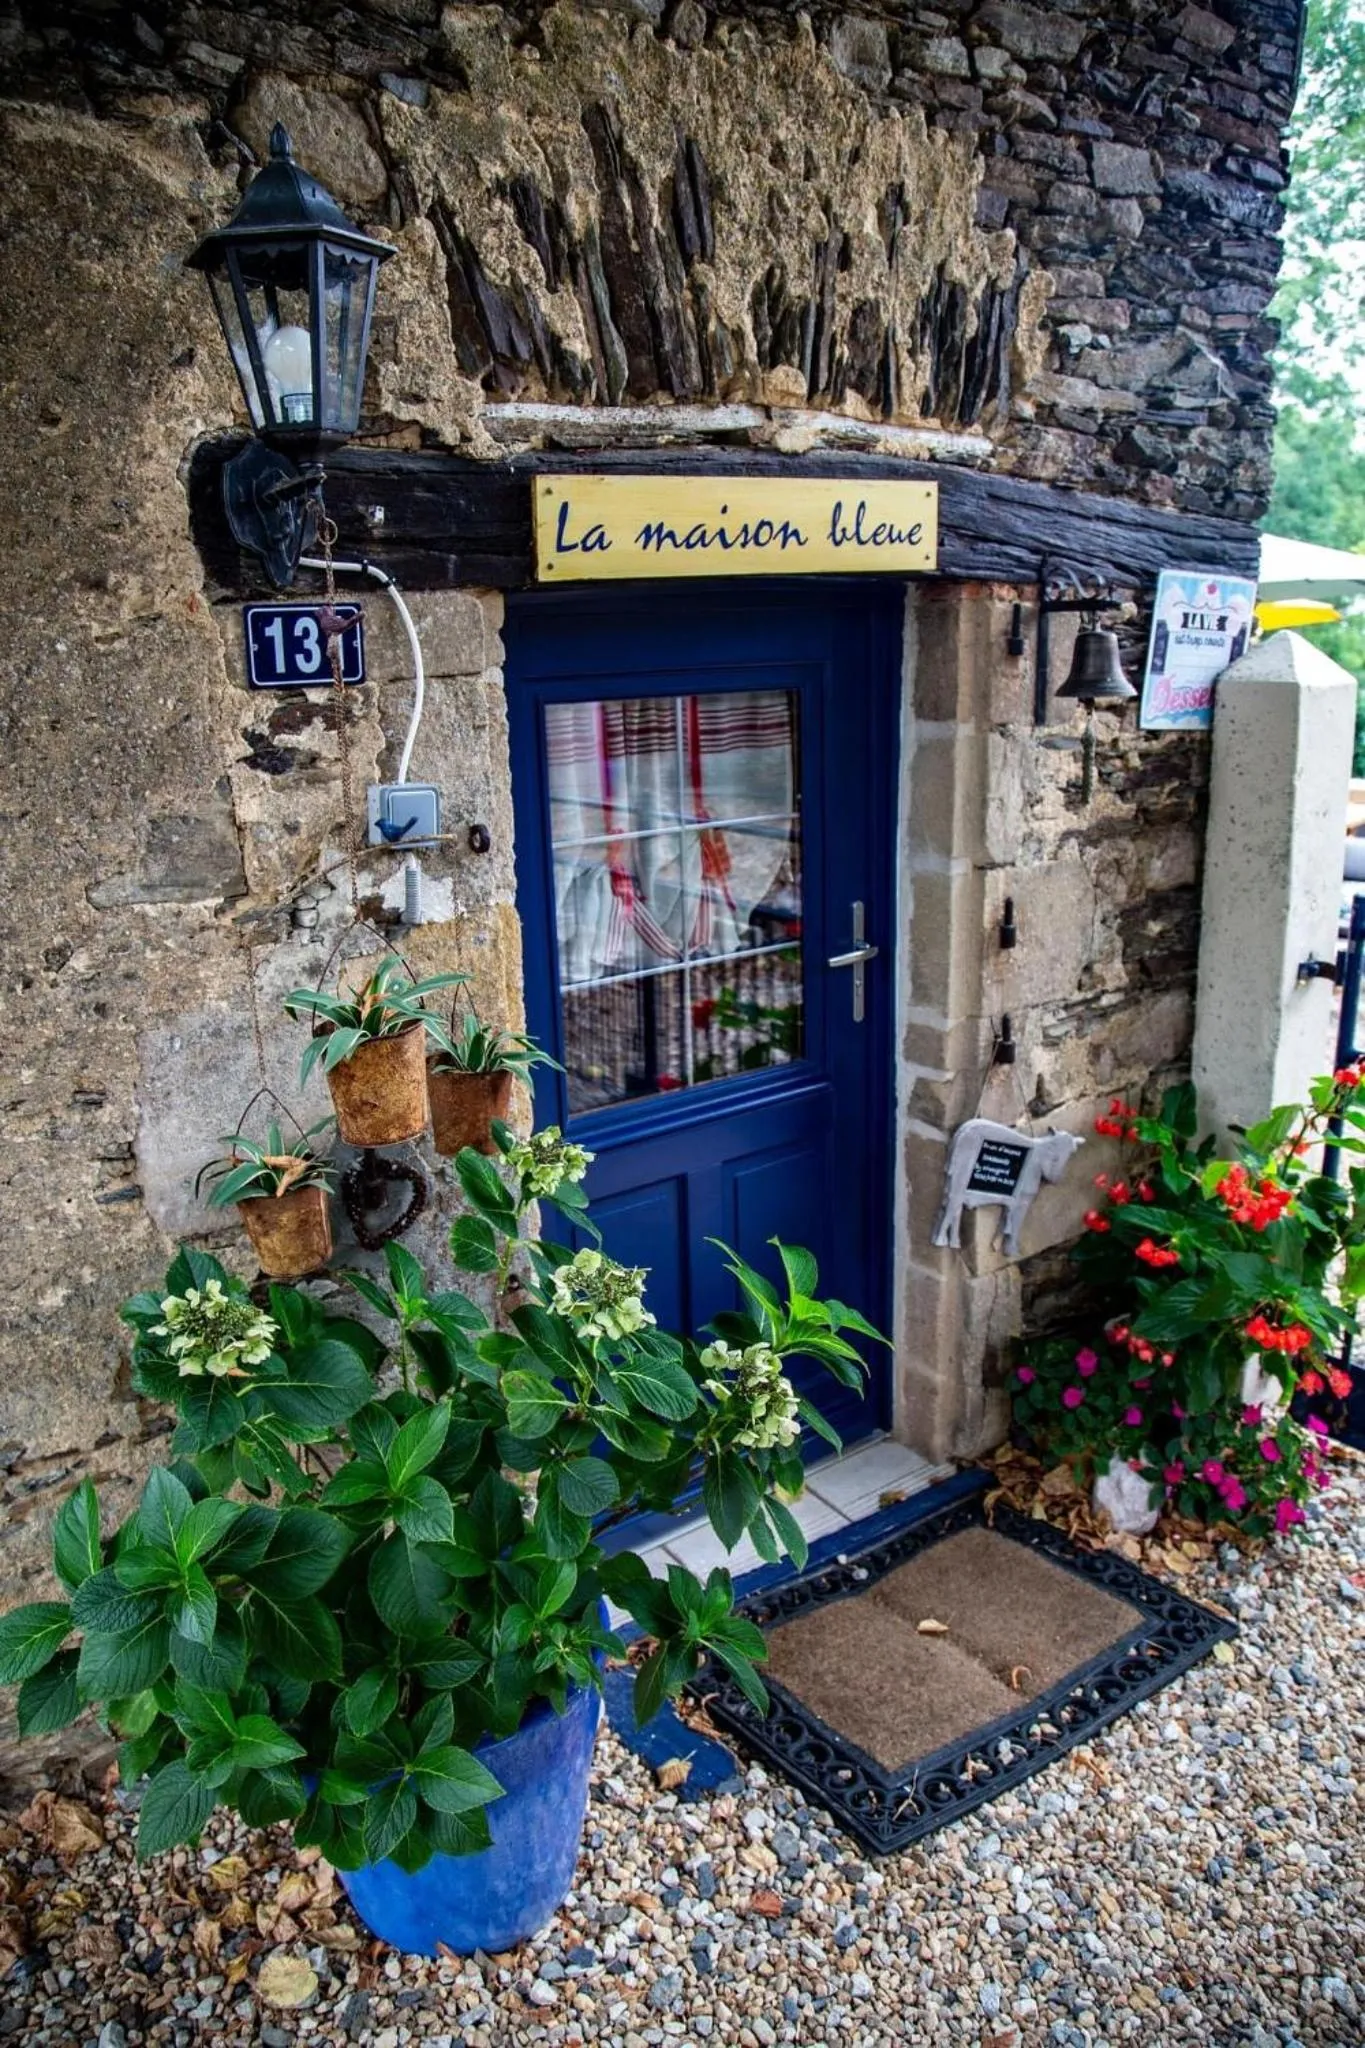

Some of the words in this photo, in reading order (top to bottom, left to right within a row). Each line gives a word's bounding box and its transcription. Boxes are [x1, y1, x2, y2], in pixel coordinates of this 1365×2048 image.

[556, 502, 612, 552] La
[635, 505, 808, 551] maison
[828, 501, 923, 547] bleue
